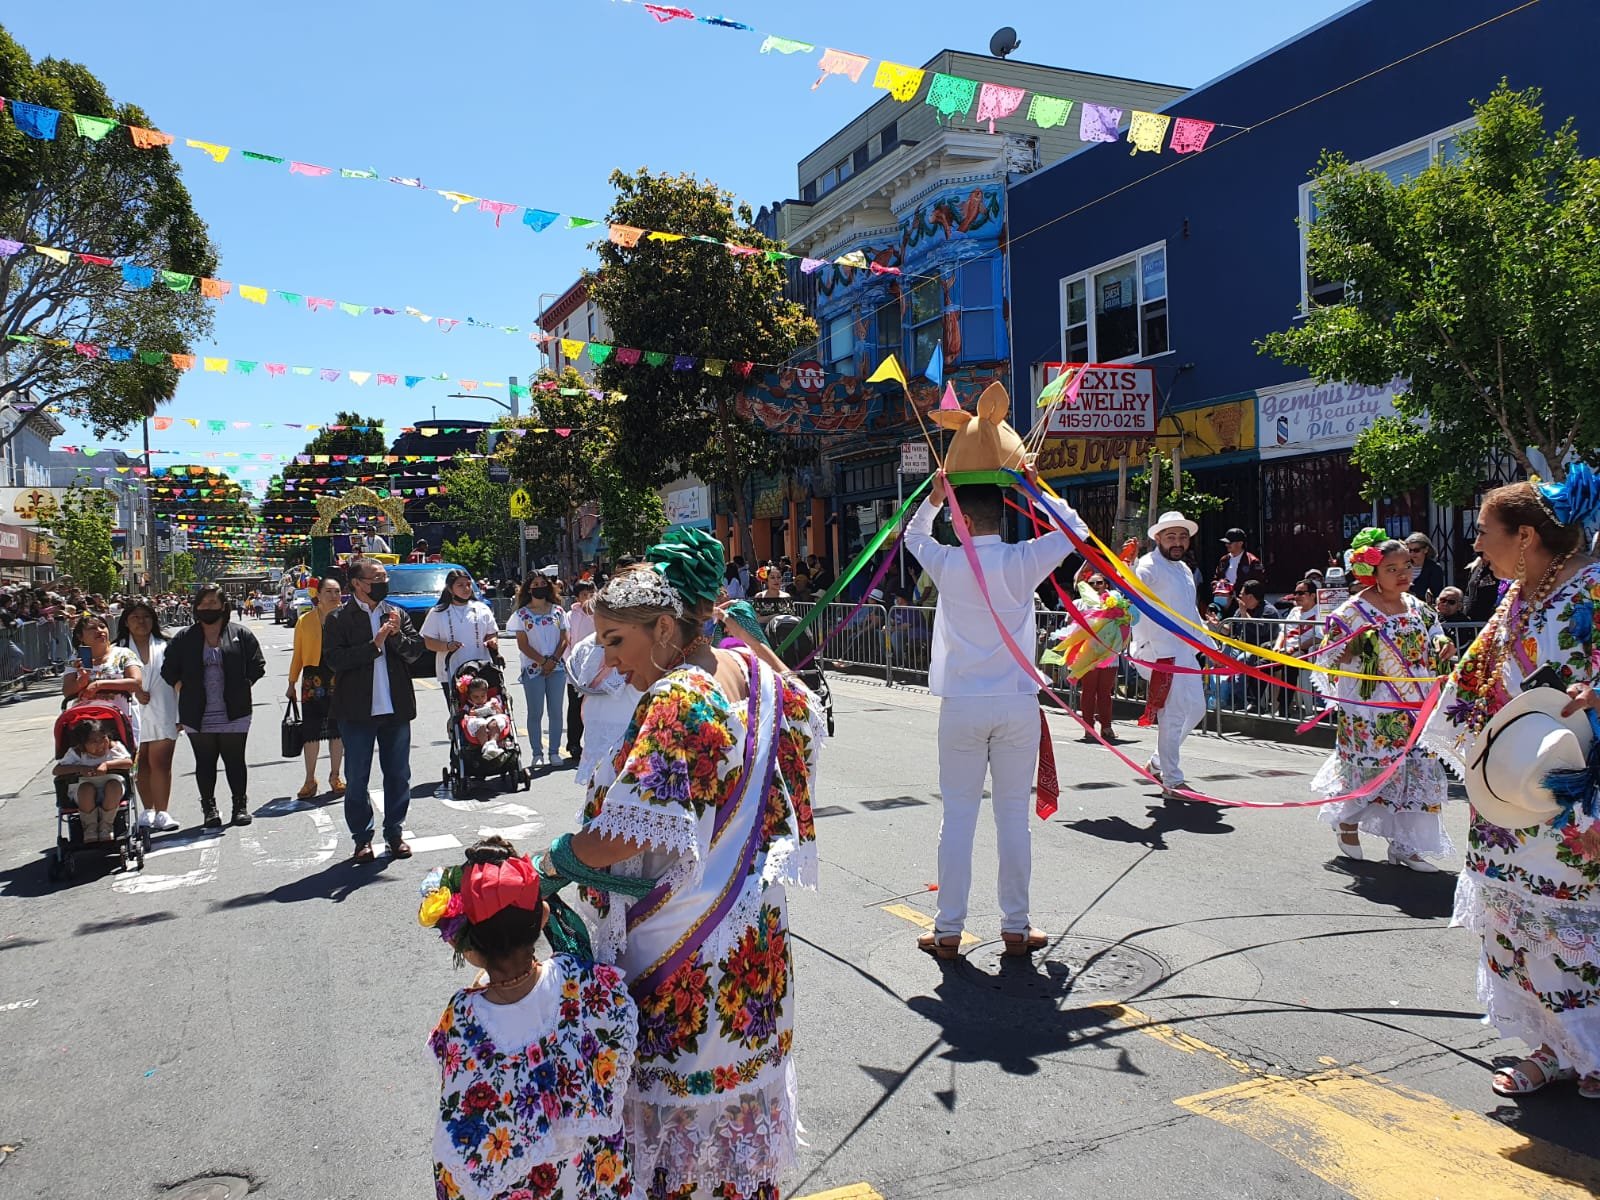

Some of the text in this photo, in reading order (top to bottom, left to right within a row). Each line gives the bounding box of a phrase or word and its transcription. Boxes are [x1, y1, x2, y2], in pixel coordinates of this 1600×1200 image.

[1071, 371, 1136, 390] EXIS
[1058, 413, 1146, 428] 415-970-0215
[1308, 400, 1381, 423] Beauty
